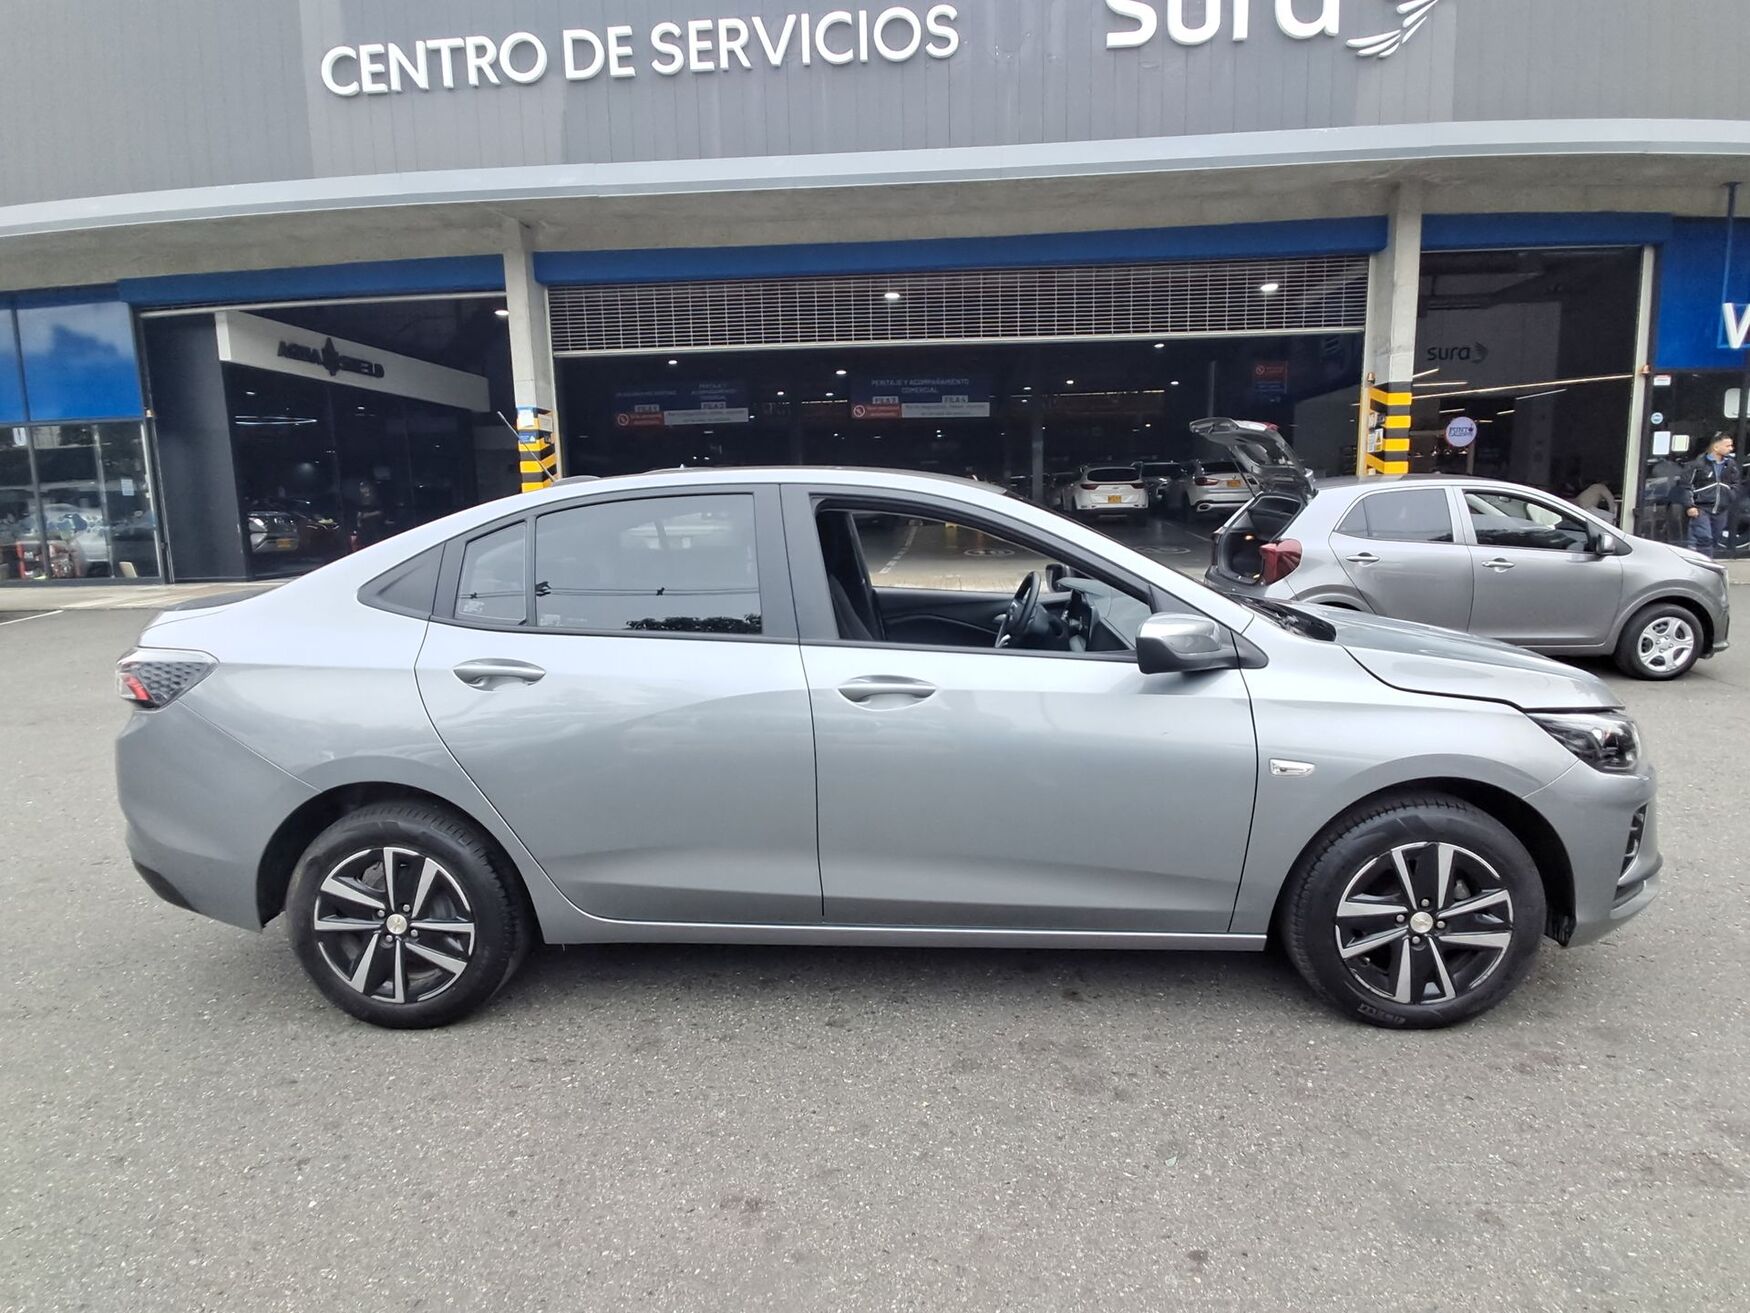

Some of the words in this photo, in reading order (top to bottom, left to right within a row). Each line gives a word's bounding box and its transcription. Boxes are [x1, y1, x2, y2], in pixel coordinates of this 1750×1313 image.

[320, 32, 548, 97] CENTRO
[562, 25, 636, 81] DE
[650, 4, 959, 76] SERVICIOS
[1427, 346, 1471, 361] sura
